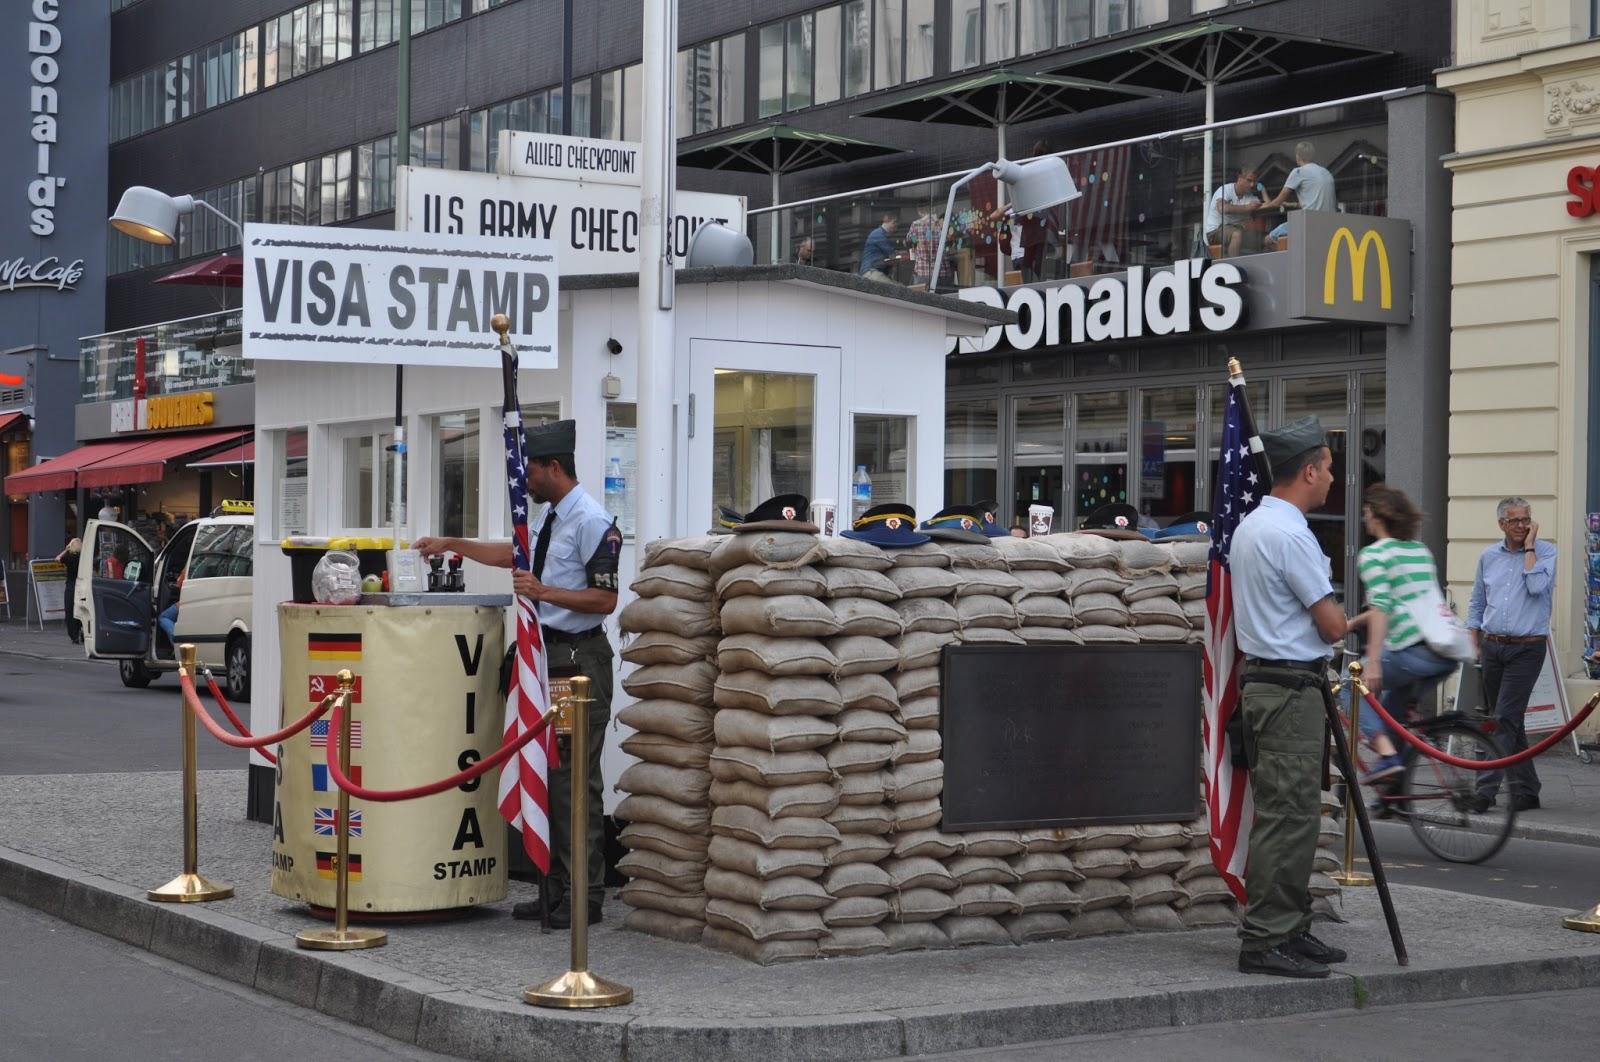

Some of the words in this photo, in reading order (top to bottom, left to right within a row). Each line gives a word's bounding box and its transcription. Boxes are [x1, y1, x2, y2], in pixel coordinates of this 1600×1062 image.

[525, 141, 562, 167] ALLIED
[567, 145, 637, 174] CHECKPOINT
[1566, 164, 1600, 218] S
[479, 198, 558, 239] ARMY
[0, 256, 84, 291] McCafé
[254, 257, 372, 327] VISA
[387, 264, 550, 335] STAMP
[452, 633, 485, 851] VISA
[433, 857, 497, 882] STAMP
